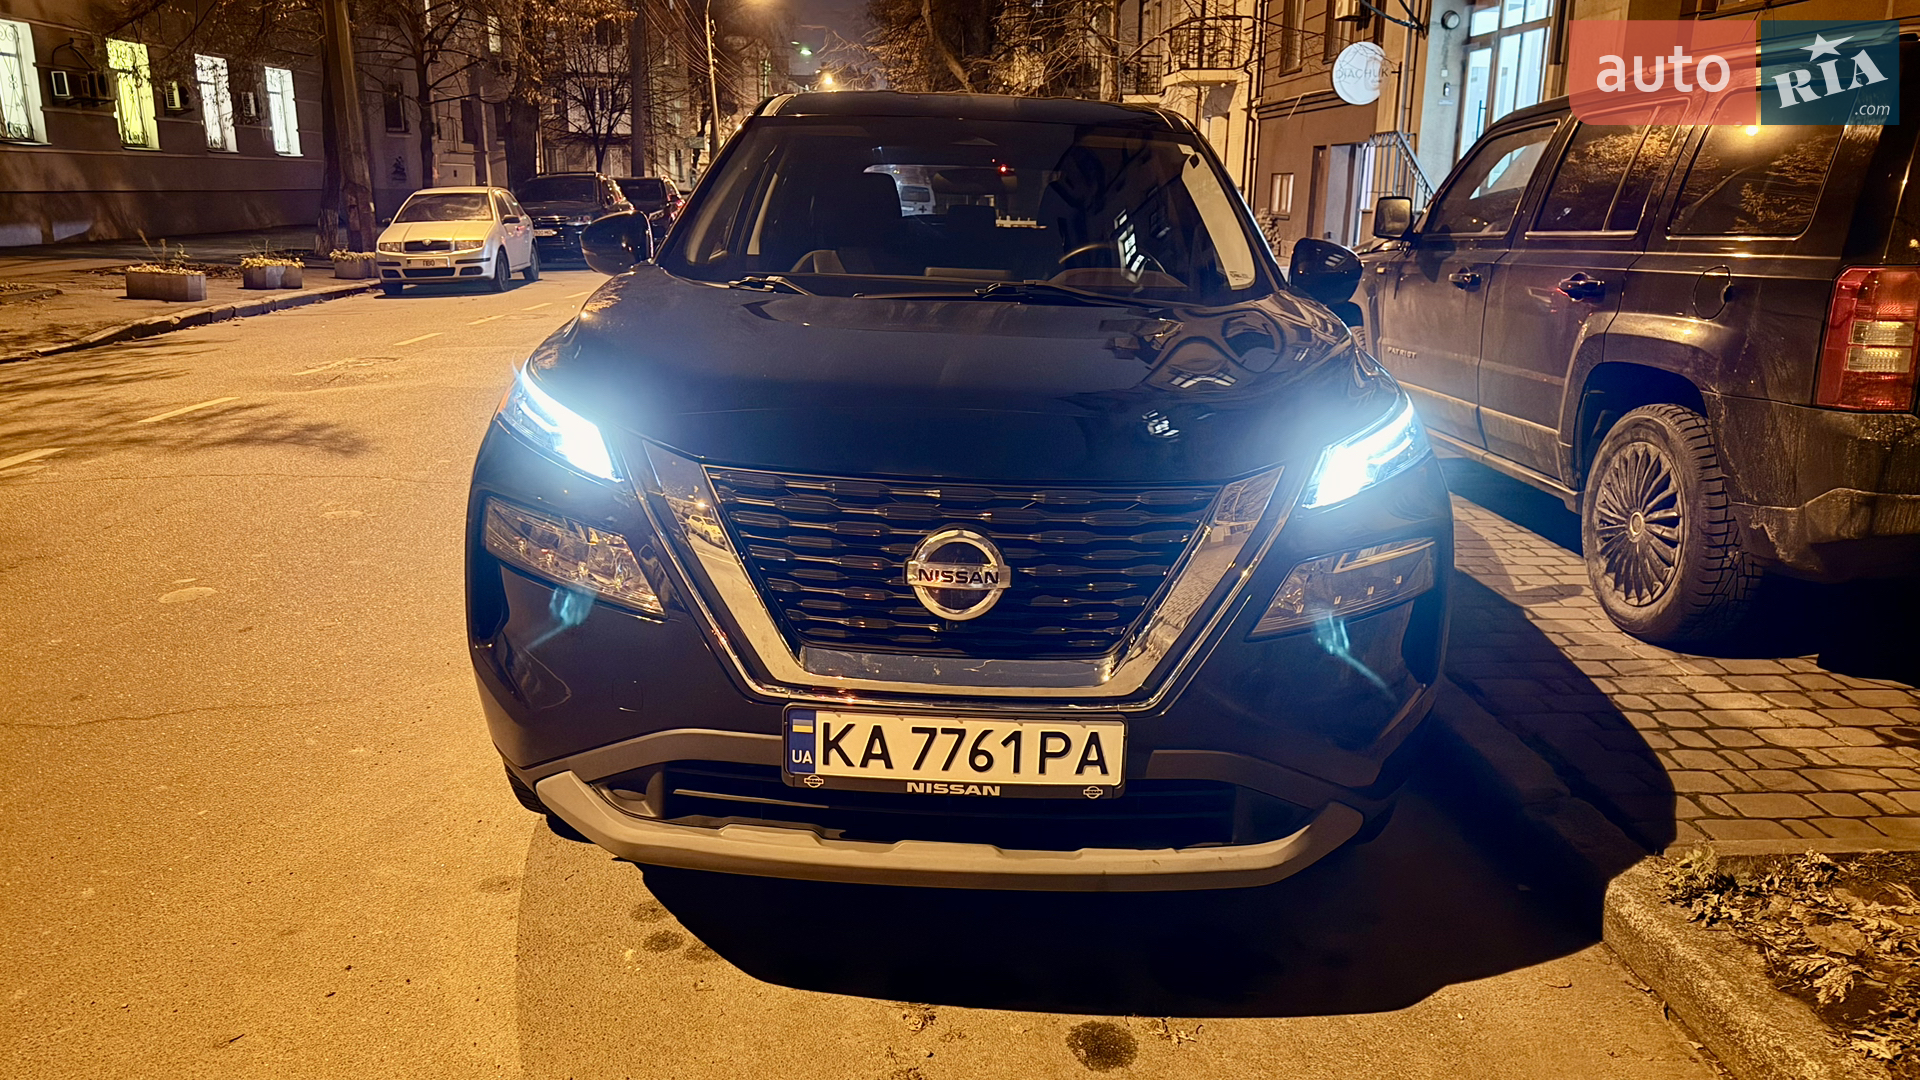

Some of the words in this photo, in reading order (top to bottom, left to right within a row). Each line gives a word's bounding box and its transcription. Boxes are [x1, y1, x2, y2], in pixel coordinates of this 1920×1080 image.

[1387, 346, 1417, 359] PATRIOT
[918, 568, 999, 584] NISSAN
[792, 749, 812, 764] UA
[821, 722, 894, 770] KA
[911, 726, 1022, 775] 7761
[1038, 730, 1108, 775] PA
[906, 781, 1000, 797] NISSAN
